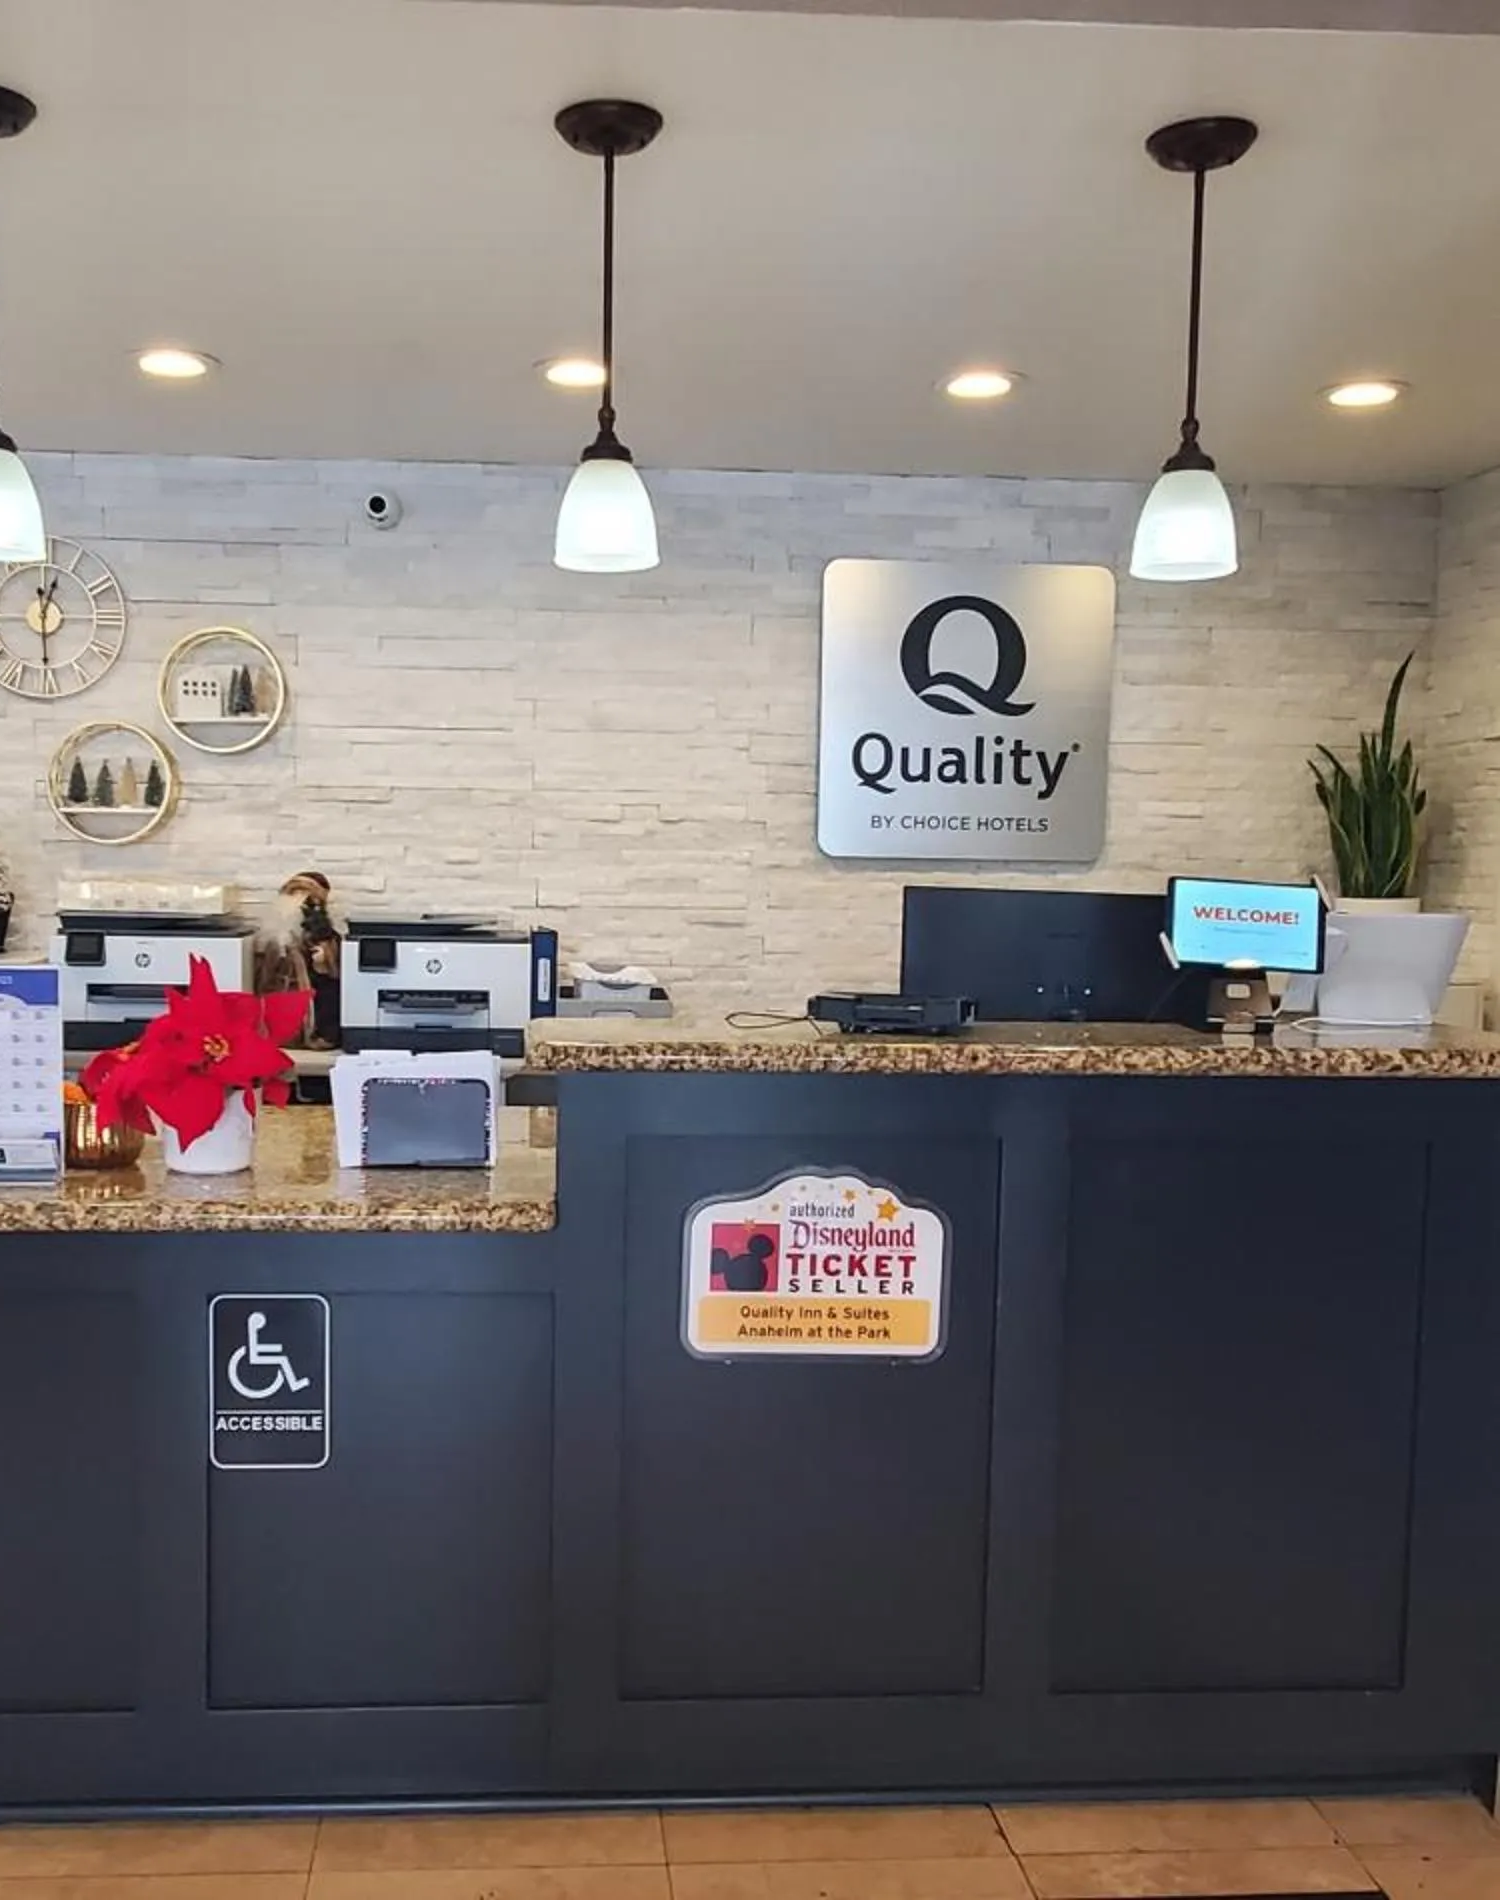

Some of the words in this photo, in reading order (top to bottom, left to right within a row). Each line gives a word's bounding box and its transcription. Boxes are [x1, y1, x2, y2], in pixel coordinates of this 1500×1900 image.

[900, 595, 1037, 717] Q
[852, 732, 1069, 800] Quality
[870, 815, 894, 829] BY
[901, 815, 971, 831] CHOICE
[977, 816, 1049, 833] HOTELS
[1193, 905, 1300, 926] WELCOME!
[789, 1203, 855, 1218] authorized
[788, 1219, 915, 1251] Disneyland
[786, 1254, 917, 1278] TICKET
[788, 1279, 915, 1295] SELLER
[740, 1305, 794, 1321] Quality
[800, 1307, 823, 1319] Inn
[827, 1307, 837, 1319] &
[843, 1307, 890, 1321] Suites
[737, 1324, 803, 1338] Anaheim
[807, 1325, 822, 1338] at
[827, 1325, 853, 1339] the
[857, 1325, 892, 1339] Park
[216, 1416, 322, 1431] ACCESSIBLE
